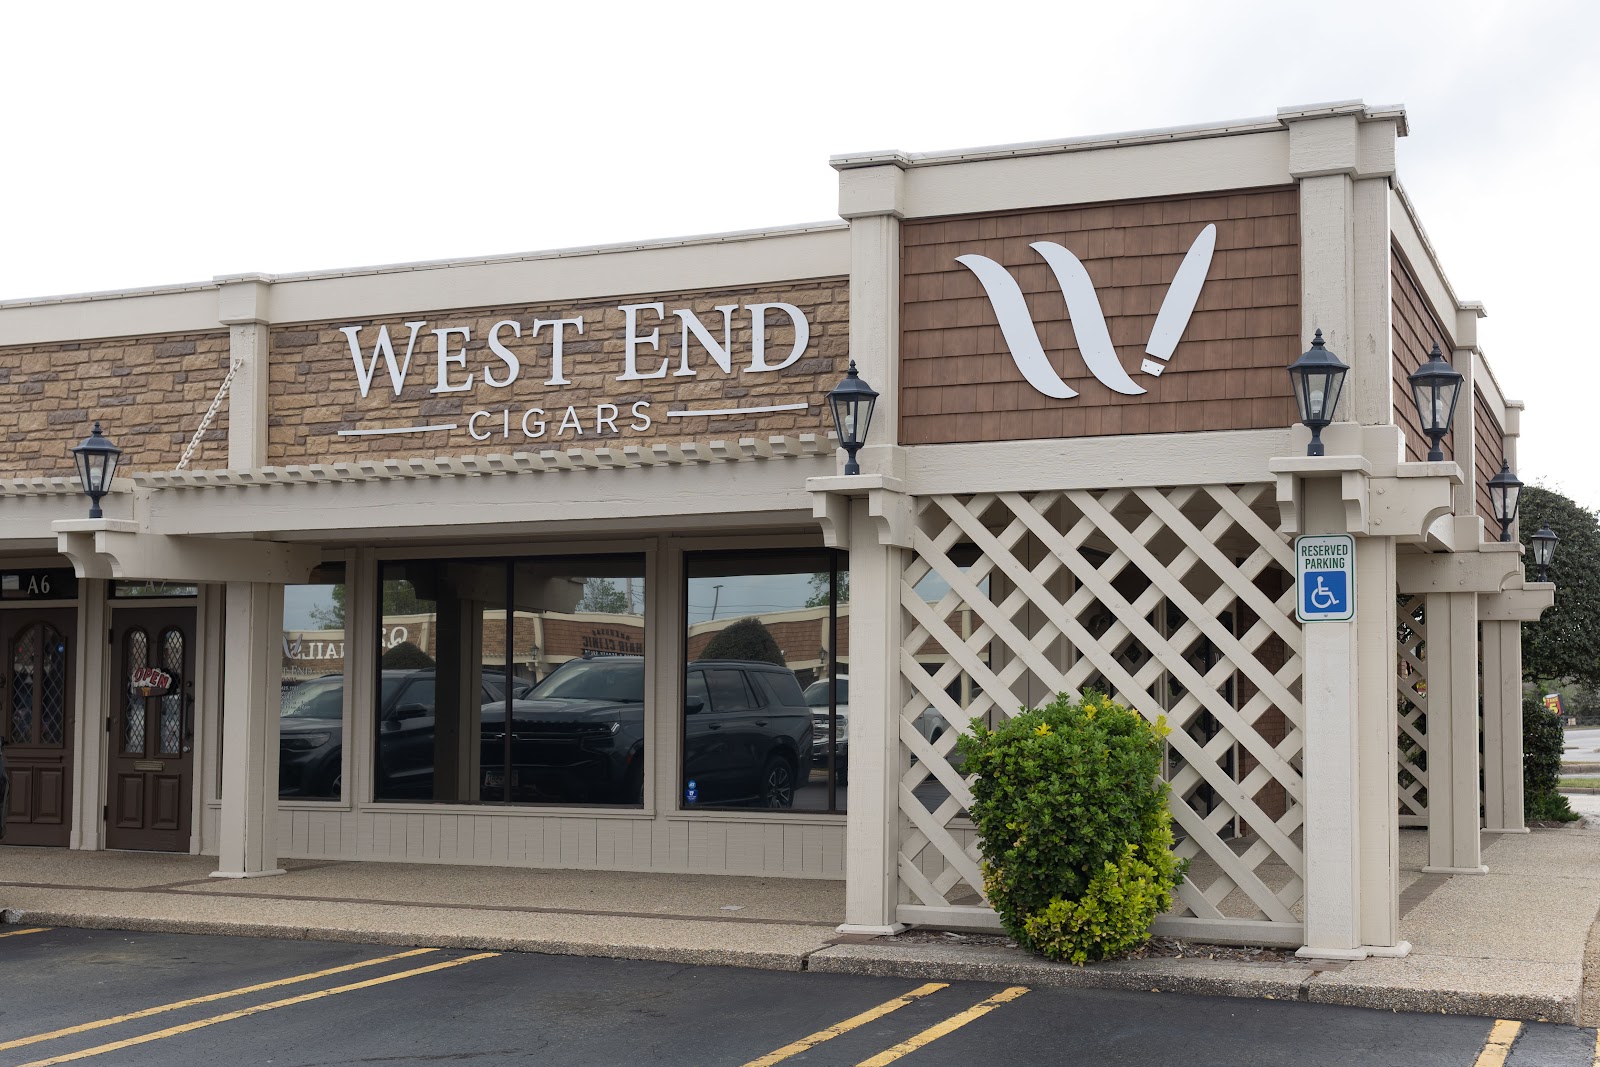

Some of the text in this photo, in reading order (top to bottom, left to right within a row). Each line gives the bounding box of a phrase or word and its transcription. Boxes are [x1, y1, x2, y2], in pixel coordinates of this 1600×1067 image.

[339, 302, 811, 398] WEST END
[467, 400, 652, 440] CIGARS
[1301, 544, 1348, 557] RESERVED
[1305, 557, 1345, 570] PARKING
[27, 575, 50, 594] A6
[135, 667, 169, 689] OPEN
